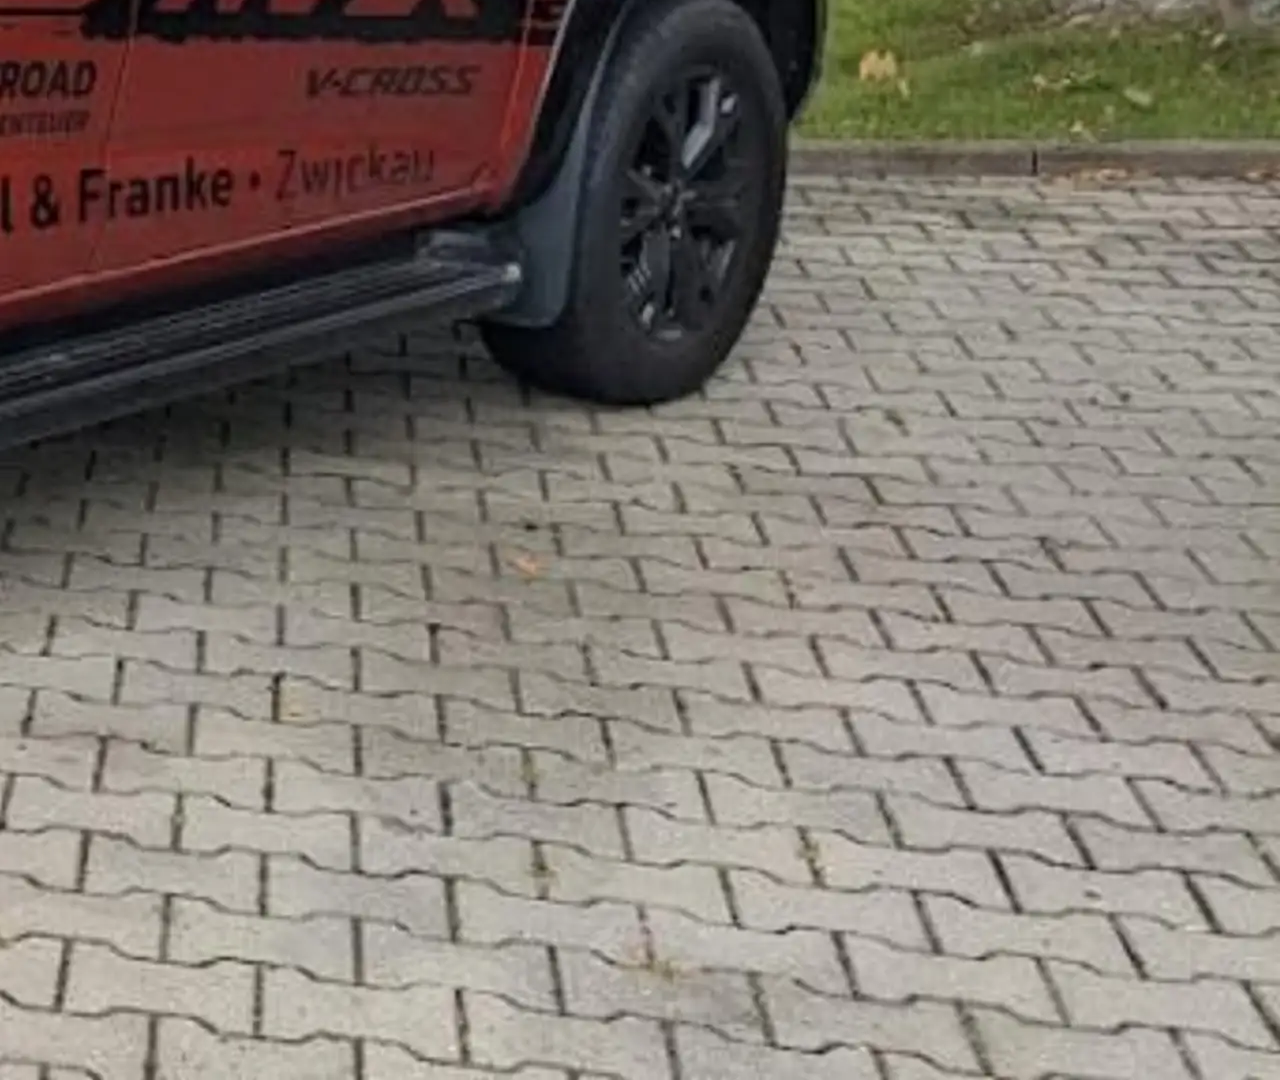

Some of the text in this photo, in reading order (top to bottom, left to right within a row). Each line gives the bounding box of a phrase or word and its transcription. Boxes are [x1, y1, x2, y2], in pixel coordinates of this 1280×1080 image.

[307, 64, 482, 98] V-CROSS
[29, 174, 60, 225] &
[78, 166, 234, 220] Franke
[275, 148, 435, 201] Zwickau
